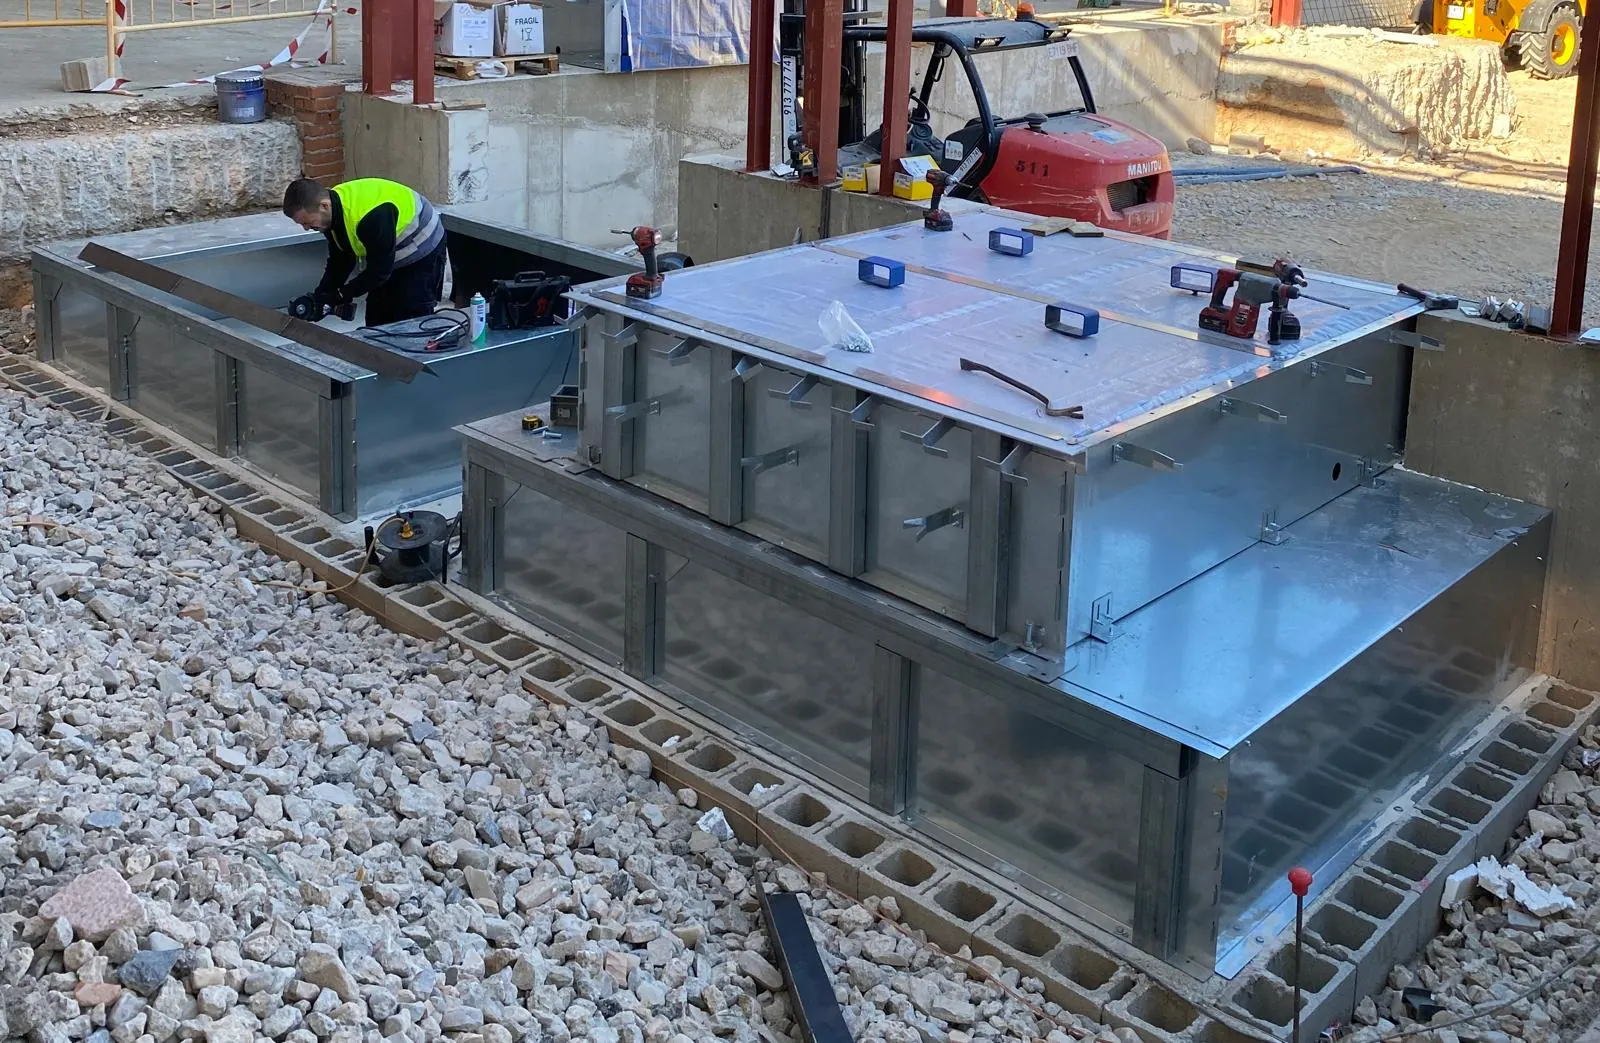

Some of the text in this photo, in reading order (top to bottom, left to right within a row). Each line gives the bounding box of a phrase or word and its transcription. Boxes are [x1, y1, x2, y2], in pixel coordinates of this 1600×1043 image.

[514, 16, 540, 26] FRAGIL
[783, 55, 792, 72] 741
[783, 76, 792, 94] 777
[783, 97, 792, 115] 913
[1016, 160, 1049, 177] 511
[1127, 160, 1162, 177] MANITOU
